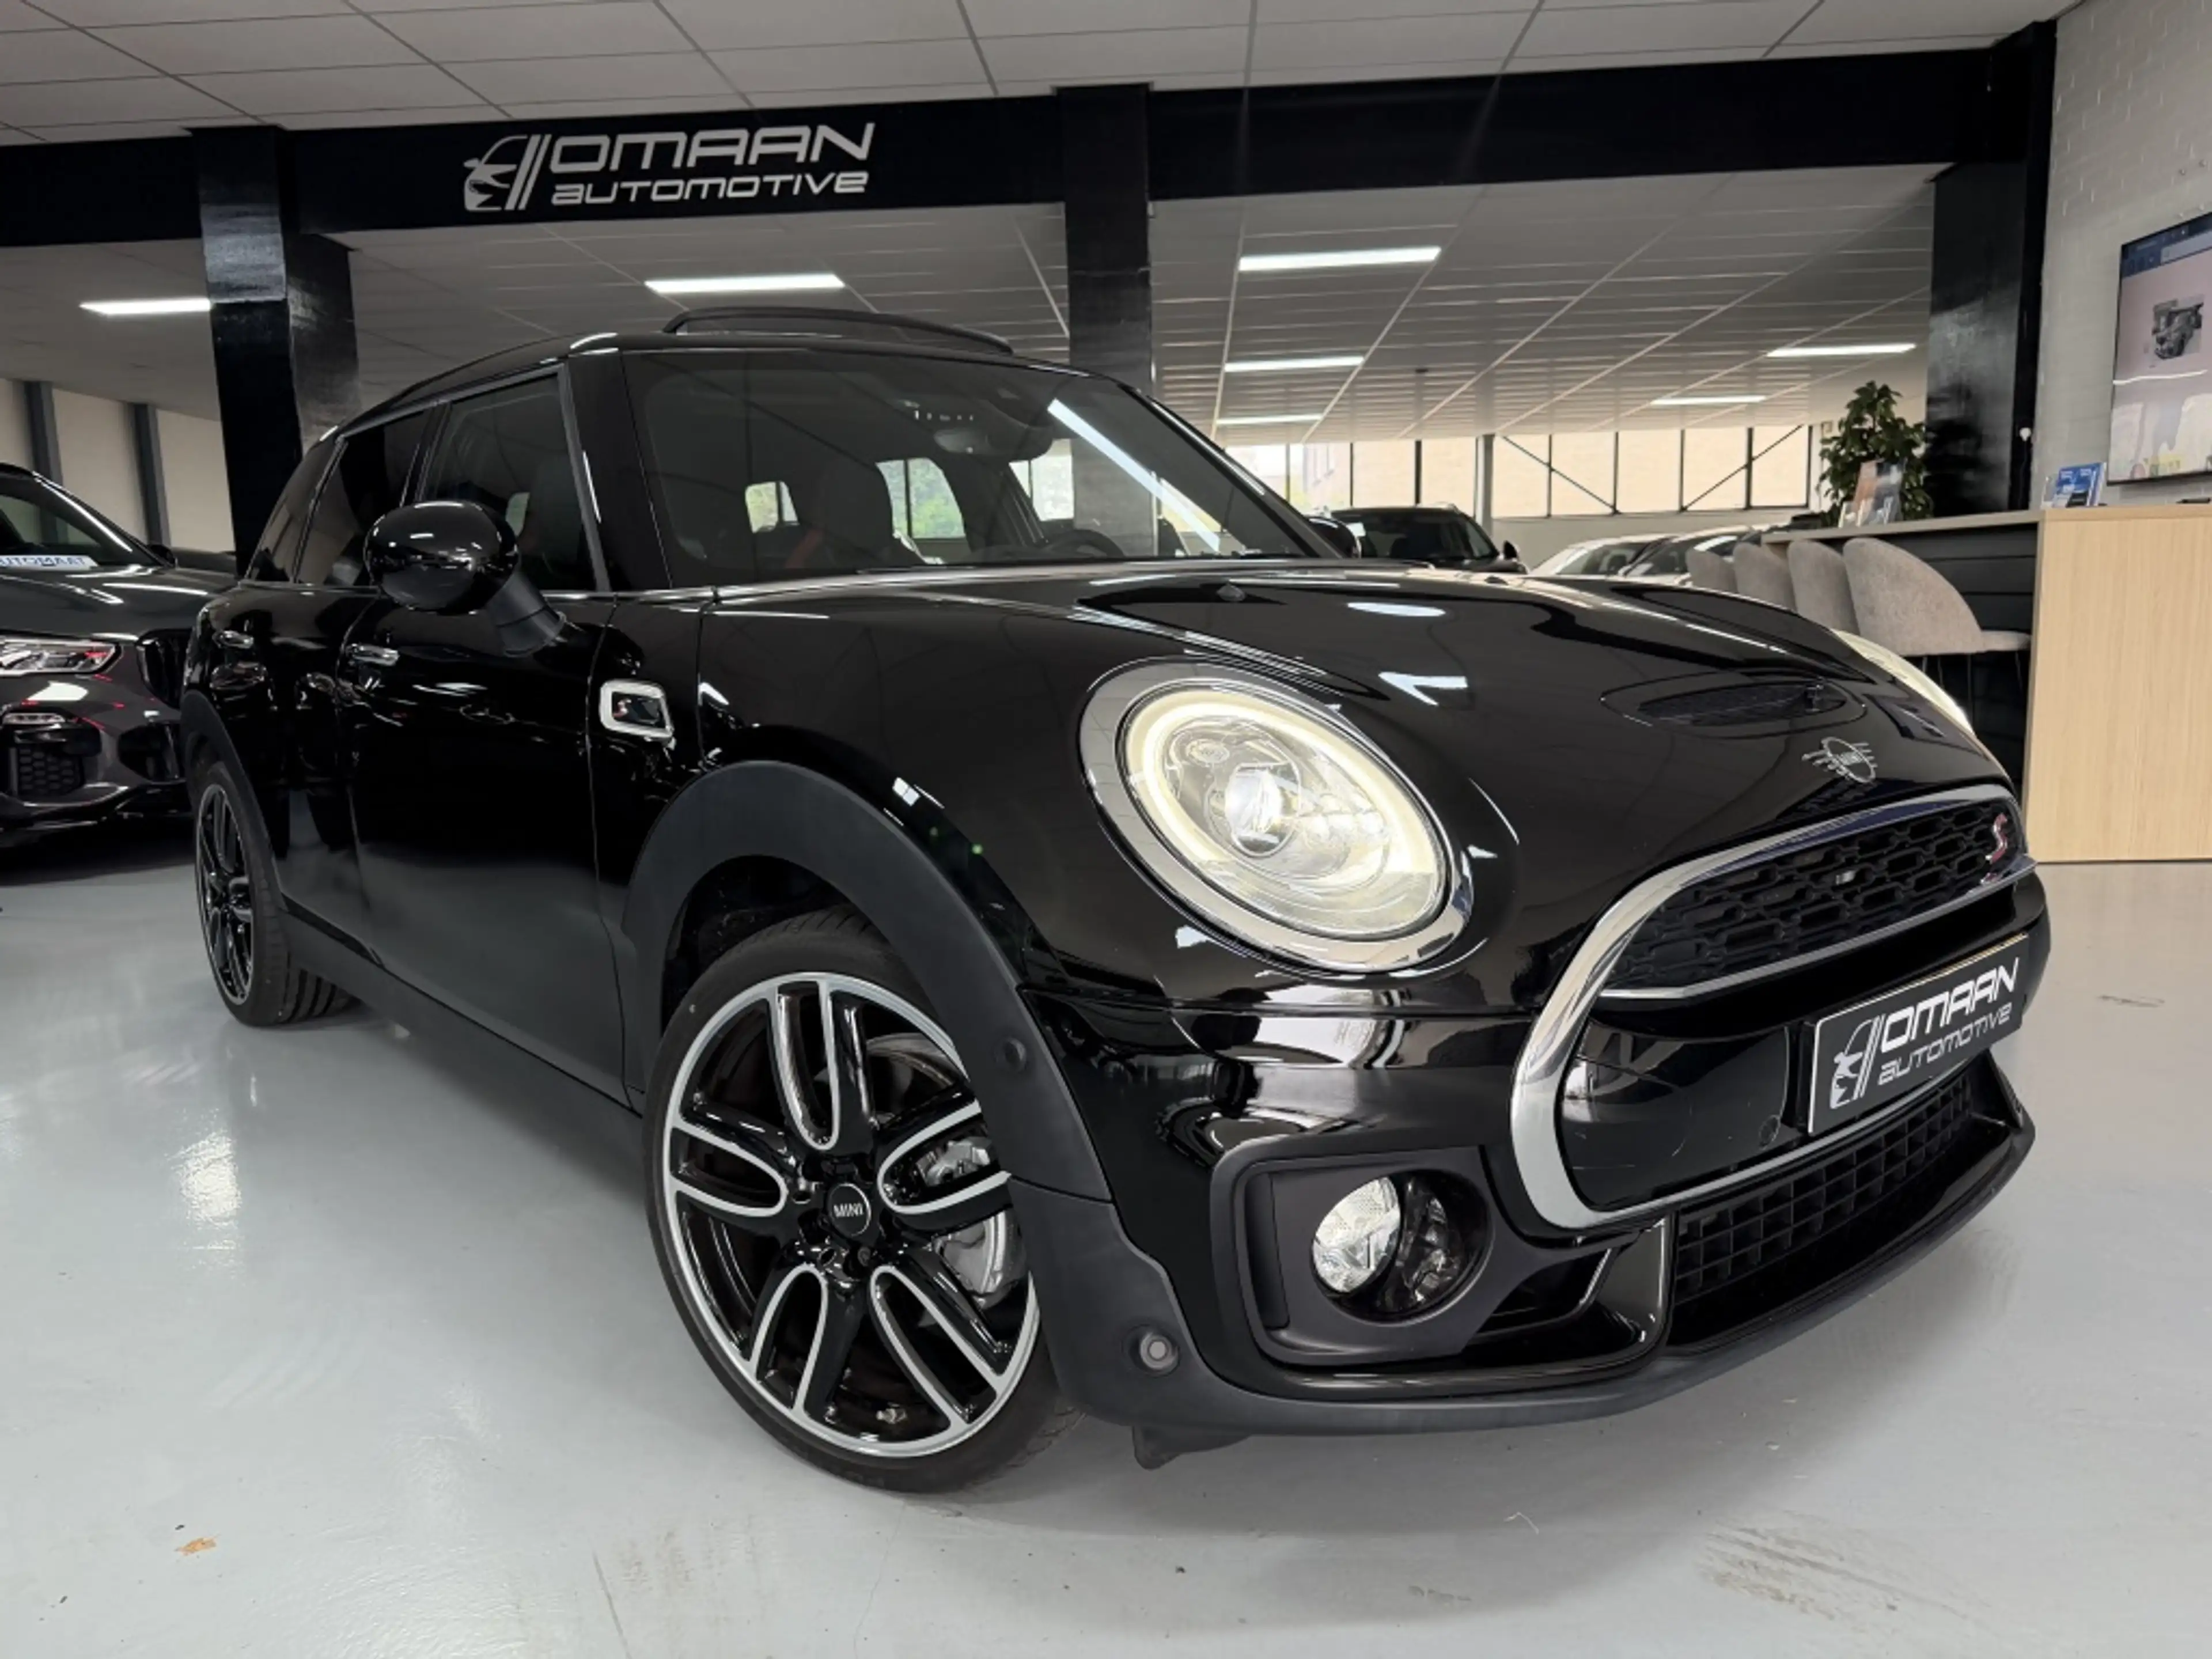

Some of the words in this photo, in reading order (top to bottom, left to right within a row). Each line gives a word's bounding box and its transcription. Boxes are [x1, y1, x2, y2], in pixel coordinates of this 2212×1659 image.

[550, 123, 875, 172] OMAAN
[1881, 957, 2019, 1054] OMAAN
[834, 1202, 863, 1218] MINI
